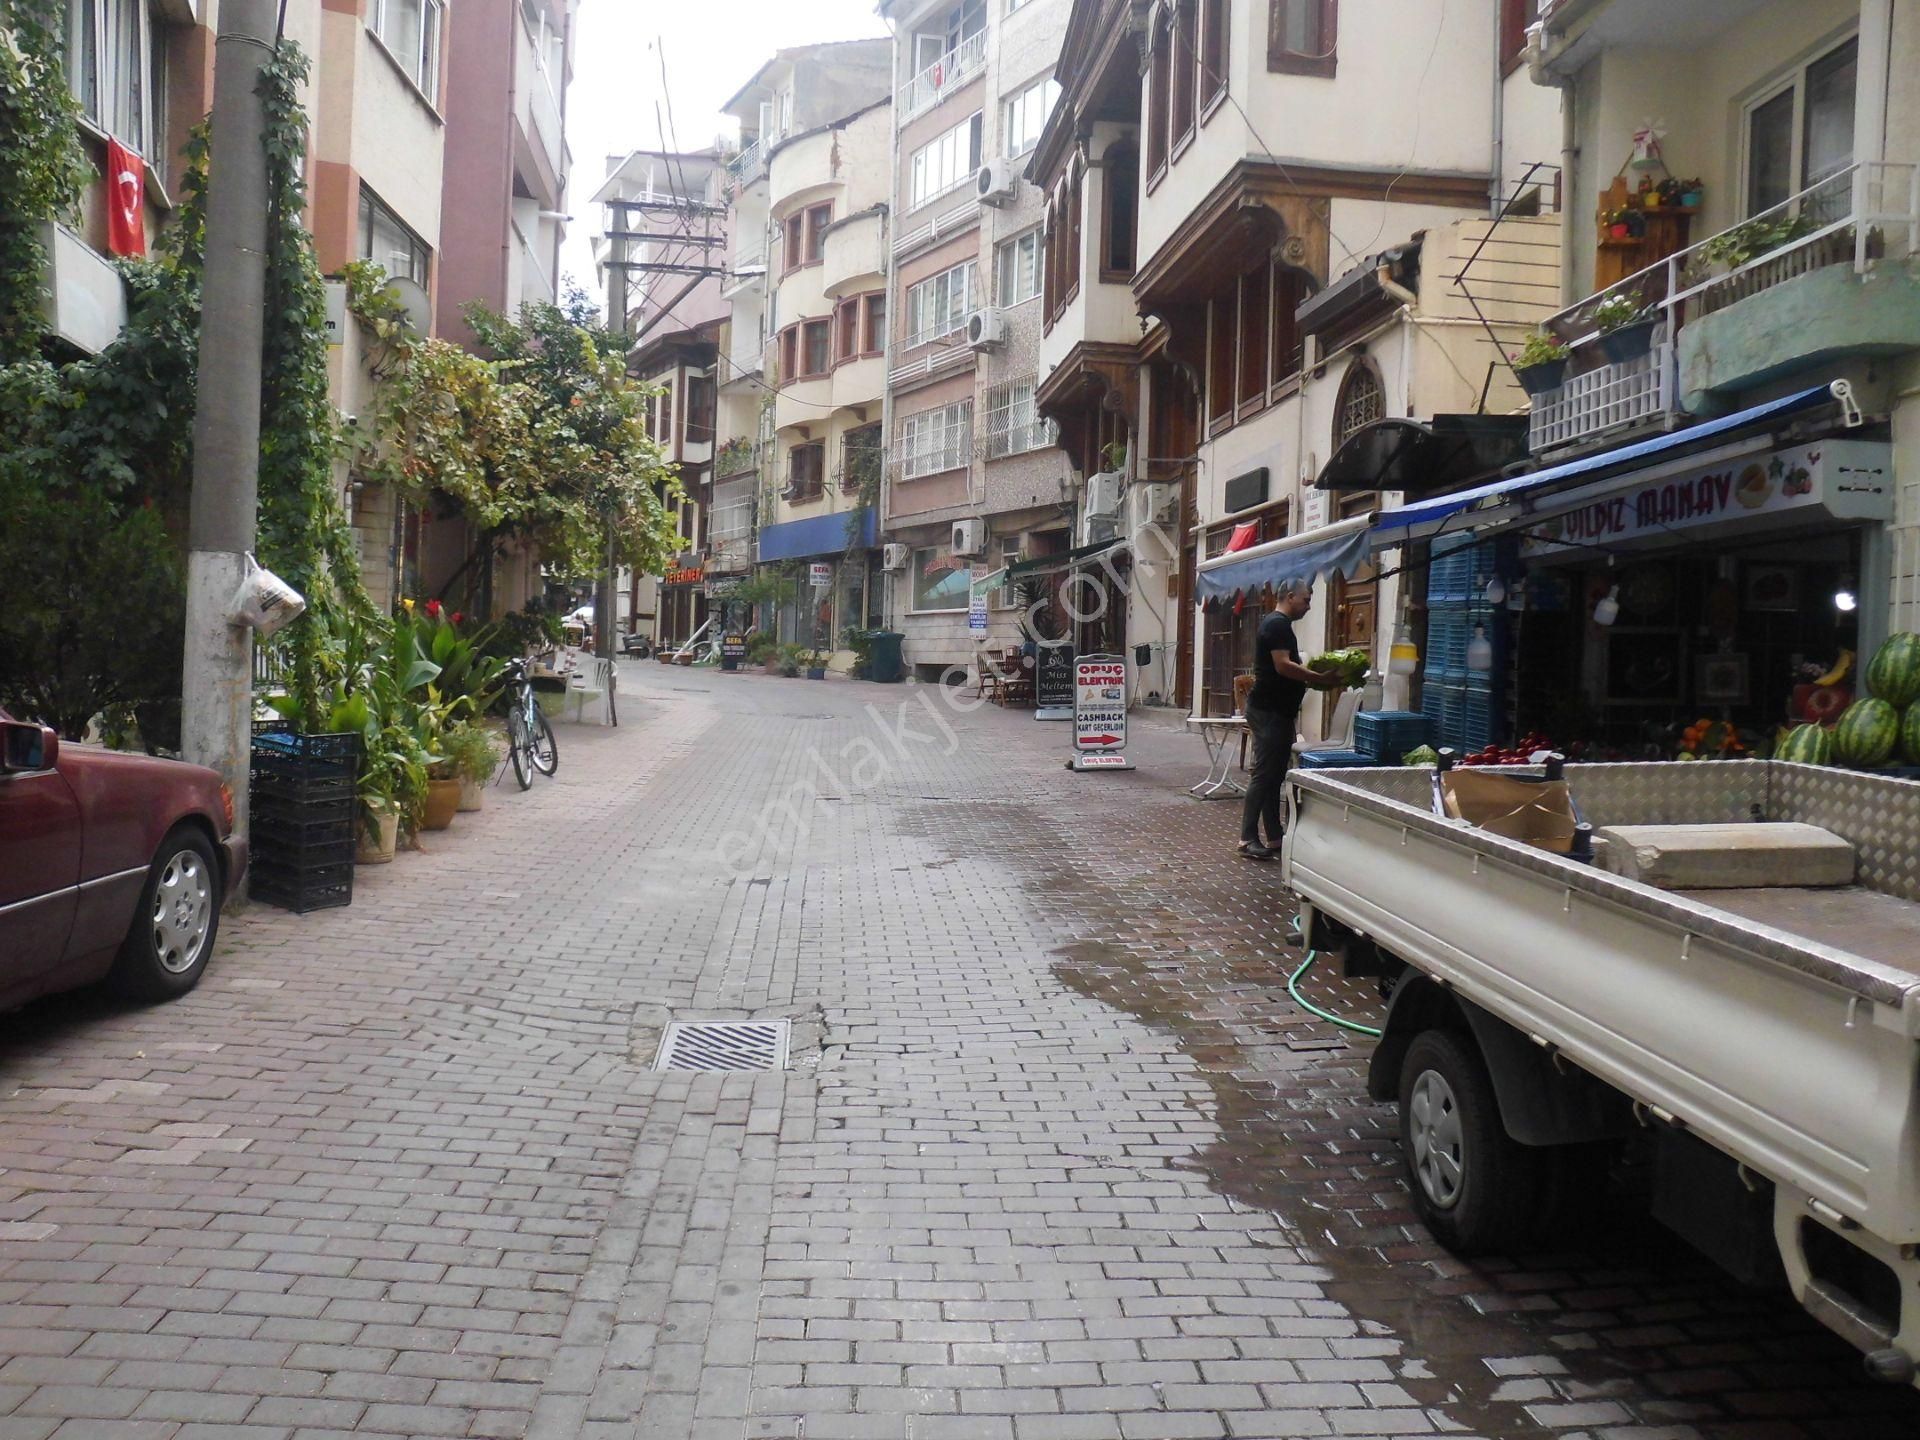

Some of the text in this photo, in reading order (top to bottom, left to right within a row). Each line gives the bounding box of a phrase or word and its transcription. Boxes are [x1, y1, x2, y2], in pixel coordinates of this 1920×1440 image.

[1566, 471, 1732, 541] YILDIZ MANAV
[1046, 671, 1067, 679] Miss
[1040, 682, 1073, 690] Meltem
[1078, 723, 1091, 731] KART
